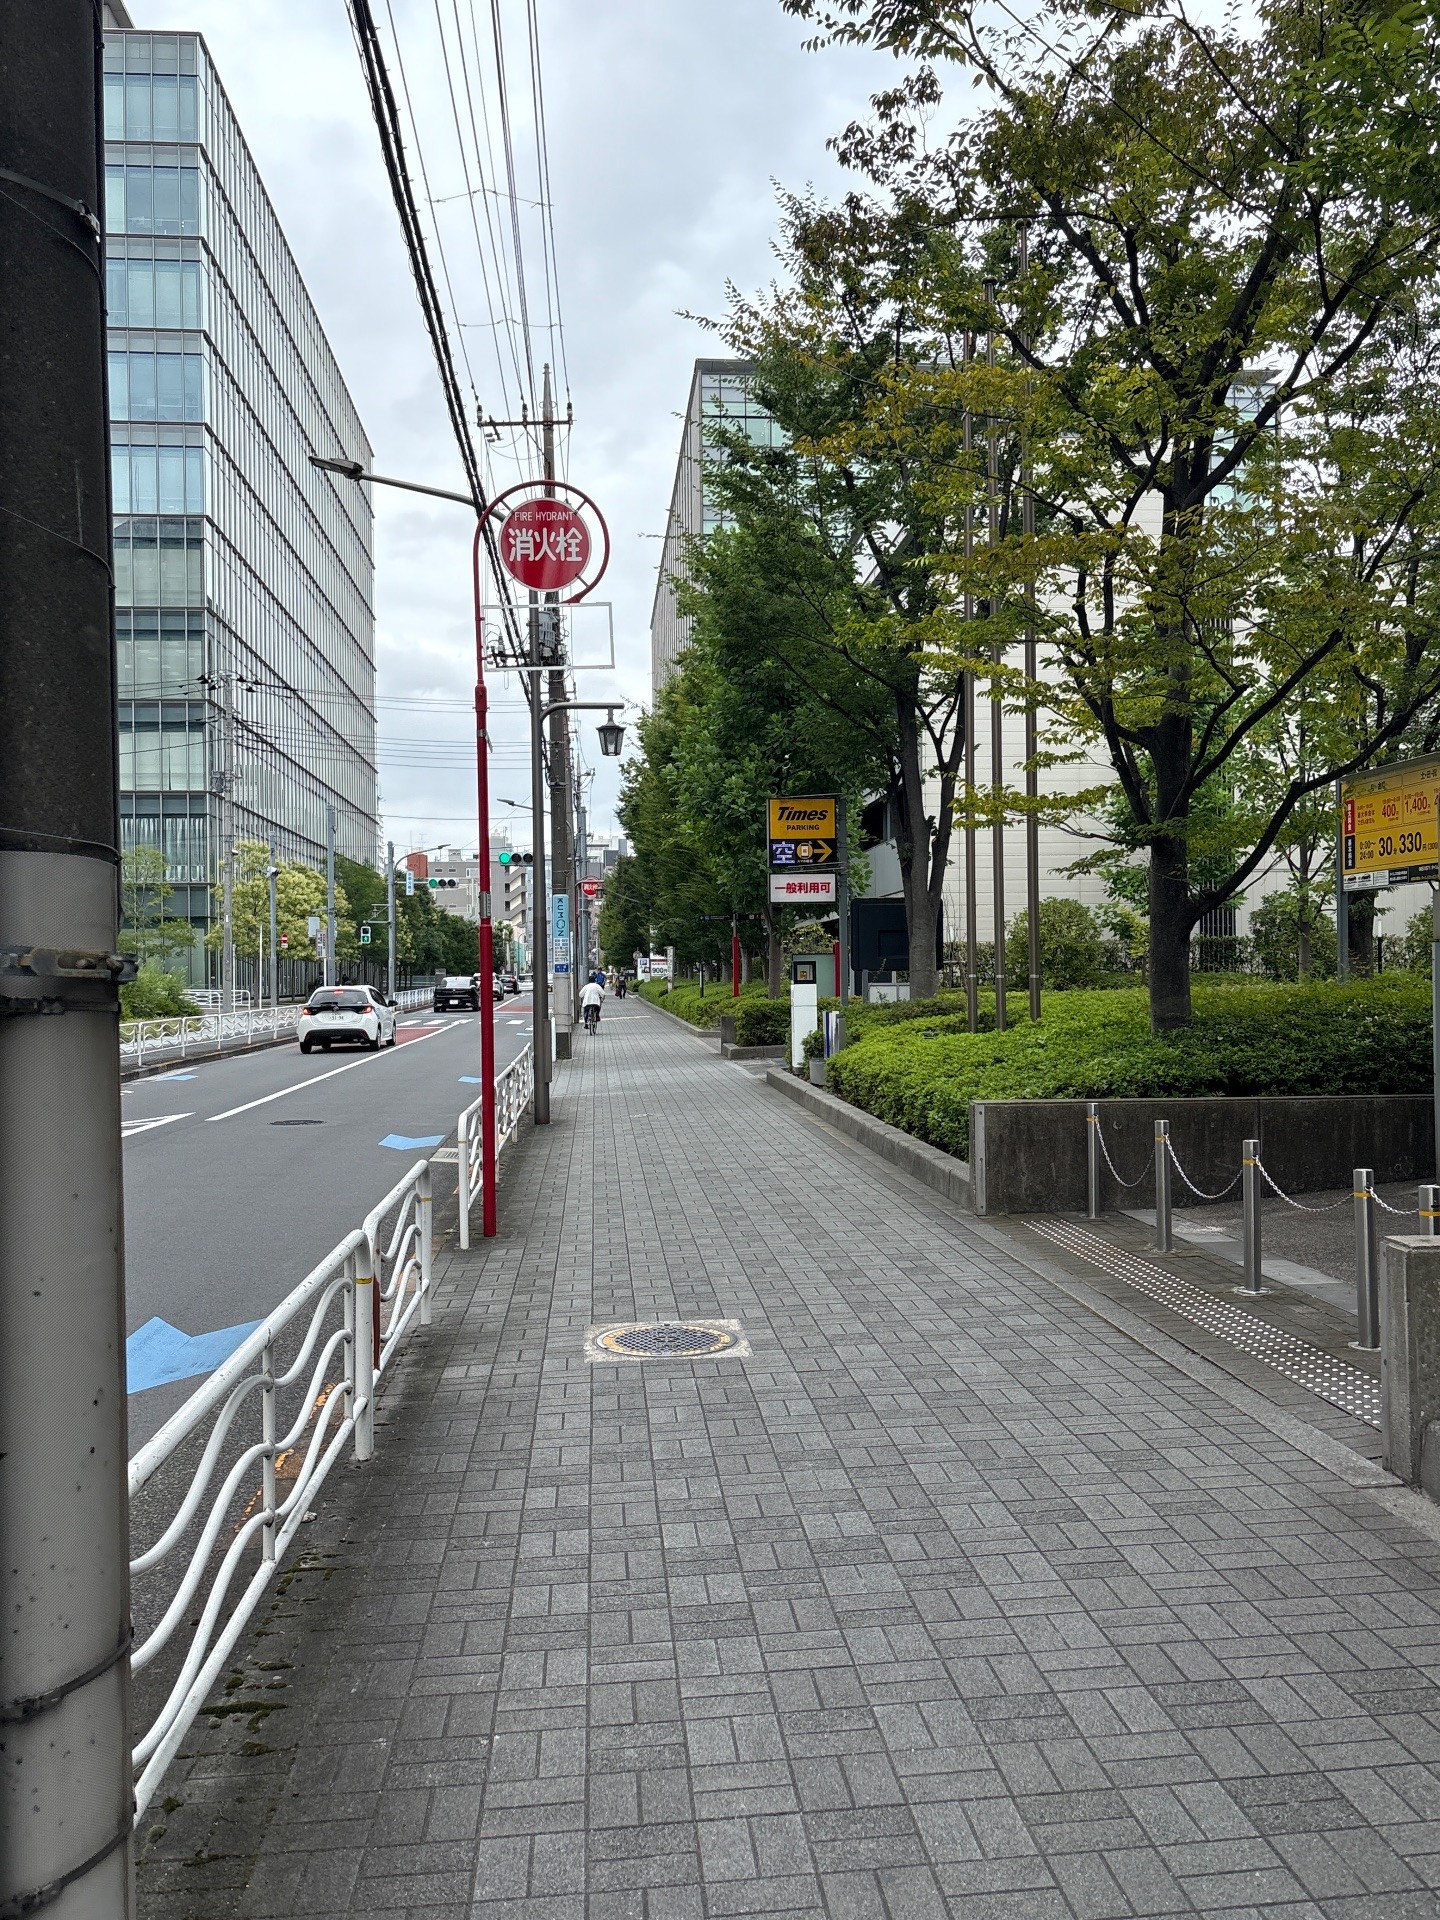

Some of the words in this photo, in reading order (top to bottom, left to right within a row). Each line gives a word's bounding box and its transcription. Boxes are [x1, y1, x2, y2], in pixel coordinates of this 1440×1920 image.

[514, 511, 533, 521] FIRE
[535, 511, 574, 521] HYDRANT
[508, 527, 583, 561] 消火栓
[777, 806, 828, 821] Times
[772, 841, 796, 864] 空
[775, 882, 831, 894] 一般利用可
[556, 897, 566, 937] KUMON
